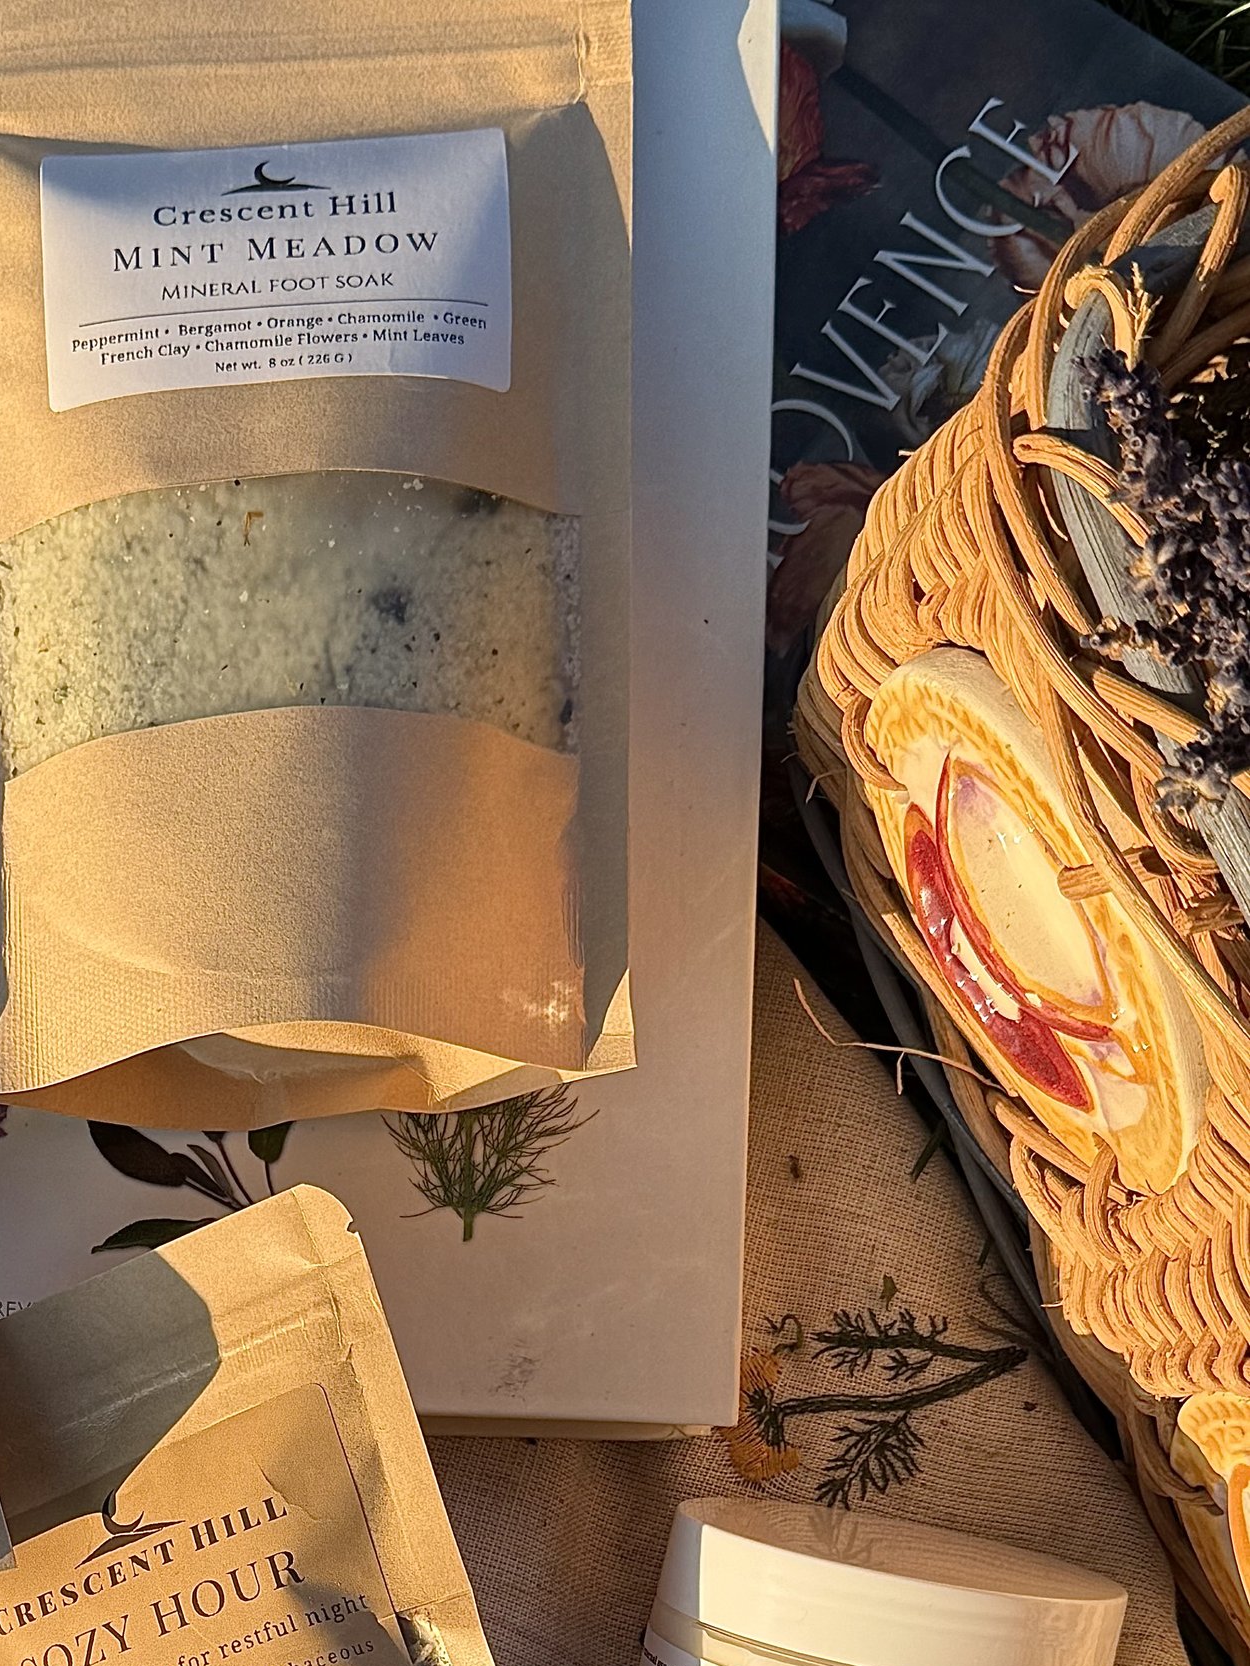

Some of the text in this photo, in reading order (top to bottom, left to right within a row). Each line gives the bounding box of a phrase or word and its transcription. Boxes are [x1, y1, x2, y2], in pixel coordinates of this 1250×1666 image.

[153, 192, 396, 226] Crescent Hill
[113, 232, 438, 271] MINT MEADOW
[162, 273, 393, 301] MINERAL FOOT SOAK
[72, 310, 486, 352] Peppermint Bergamot Orange Chamomile Green
[101, 329, 465, 365] French Clay Chamomile Flowers Mint Leaves
[215, 357, 294, 373] Net 8 oz
[190, 1497, 288, 1552] HILL
[151, 1551, 306, 1637] HOUR
[218, 1615, 297, 1659] restful
[307, 1592, 368, 1628] night
